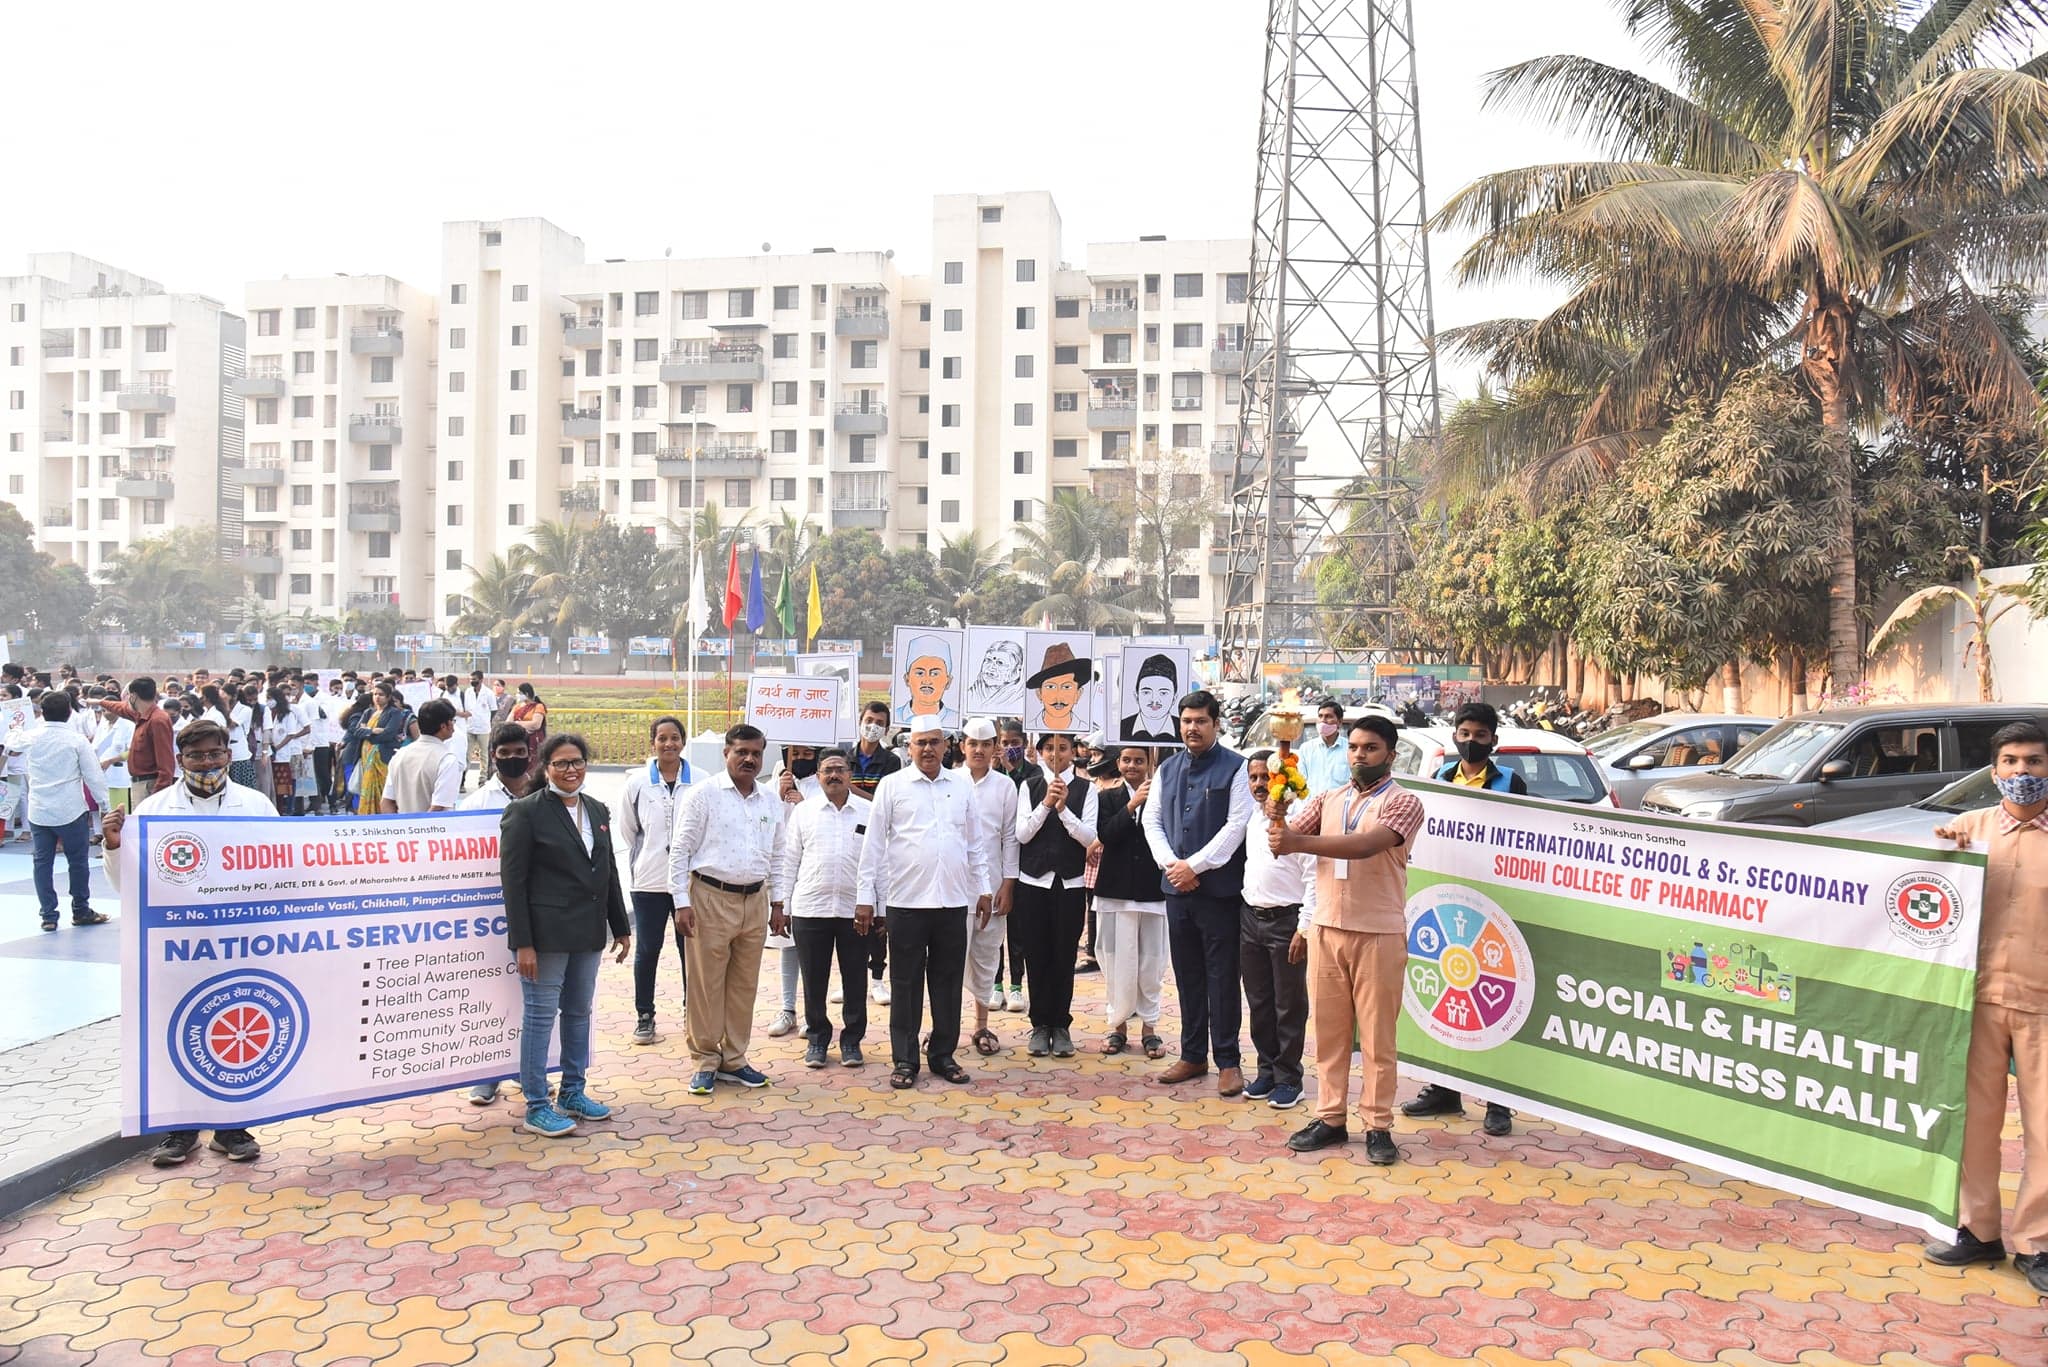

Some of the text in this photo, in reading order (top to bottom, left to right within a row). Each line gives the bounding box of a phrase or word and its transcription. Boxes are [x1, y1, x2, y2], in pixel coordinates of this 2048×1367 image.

[758, 683, 829, 702] व्यर्थ ना जाए
[755, 703, 832, 719] बलिदान हमारा
[334, 824, 446, 837] S.S.P. Shikshan Sanstha
[1572, 822, 1686, 847] S.S.P. Shikshan Sanstha
[221, 836, 502, 871] SIDDHI COLLEGE OF PHARM
[1427, 817, 1869, 906] GANESH INTERNATIONAL SCHOOL & Sr. SECONDARY
[197, 885, 240, 895] Approved
[241, 883, 251, 892] by
[301, 879, 317, 888] DTE
[318, 879, 325, 887] &
[350, 877, 359, 885] of
[359, 875, 408, 885] Maharashtra
[410, 874, 416, 882] &
[417, 872, 450, 881] Affiliated
[460, 871, 484, 879] MSBTE
[1494, 854, 1769, 924] SIDDHI COLLEGE OF PHARMACY
[165, 910, 182, 921] Sr.
[186, 909, 208, 920] No.
[213, 905, 281, 919] 1157-1160,
[283, 902, 325, 914] Nevale
[328, 899, 358, 911] Vasti,
[362, 896, 410, 909] Chikhali,
[165, 930, 340, 962] NATIONAL
[347, 918, 468, 949] SERVICE
[377, 949, 485, 971] Tree Plantation
[375, 972, 421, 990] Social
[424, 965, 502, 985] Awareness
[233, 986, 251, 998] सेवा
[375, 987, 470, 1008] Health Camp
[373, 999, 493, 1026] Awareness Rally
[373, 1015, 507, 1044] Community Survey
[1556, 973, 1920, 1085] SOCIAL & HEALTH
[188, 1015, 290, 1084] NATIONAL SERVICE SCHEME
[372, 1047, 416, 1062] Stage
[421, 1037, 465, 1055] Show/
[469, 1031, 504, 1048] Road
[371, 1047, 512, 1080] For Social Problems
[1541, 1013, 1942, 1141] AWARENESS RALLY
